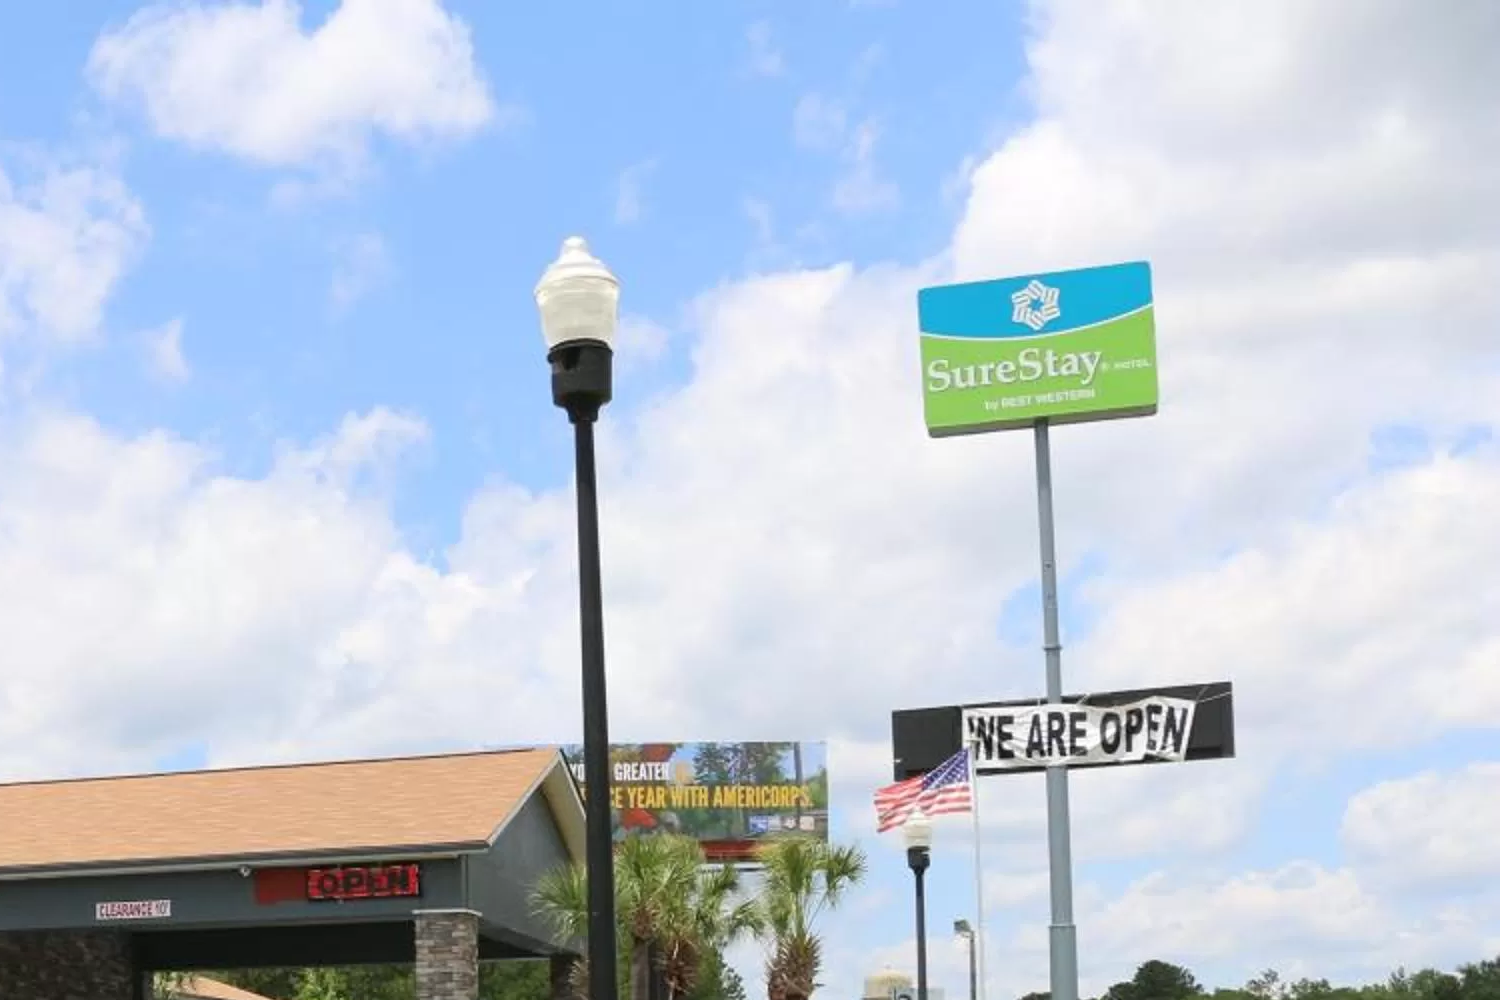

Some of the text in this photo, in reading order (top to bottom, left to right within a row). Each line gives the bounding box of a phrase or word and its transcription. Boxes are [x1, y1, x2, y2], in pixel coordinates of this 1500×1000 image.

[927, 348, 1102, 392] SureStay
[1001, 395, 1031, 409] BEST
[1035, 388, 1095, 404] WESTERN
[968, 703, 1189, 761] WE ARE OPEN
[627, 785, 666, 809] YEAR
[671, 785, 709, 809] WITH
[315, 867, 413, 896] OPEN
[100, 902, 153, 917] CLEARANCE
